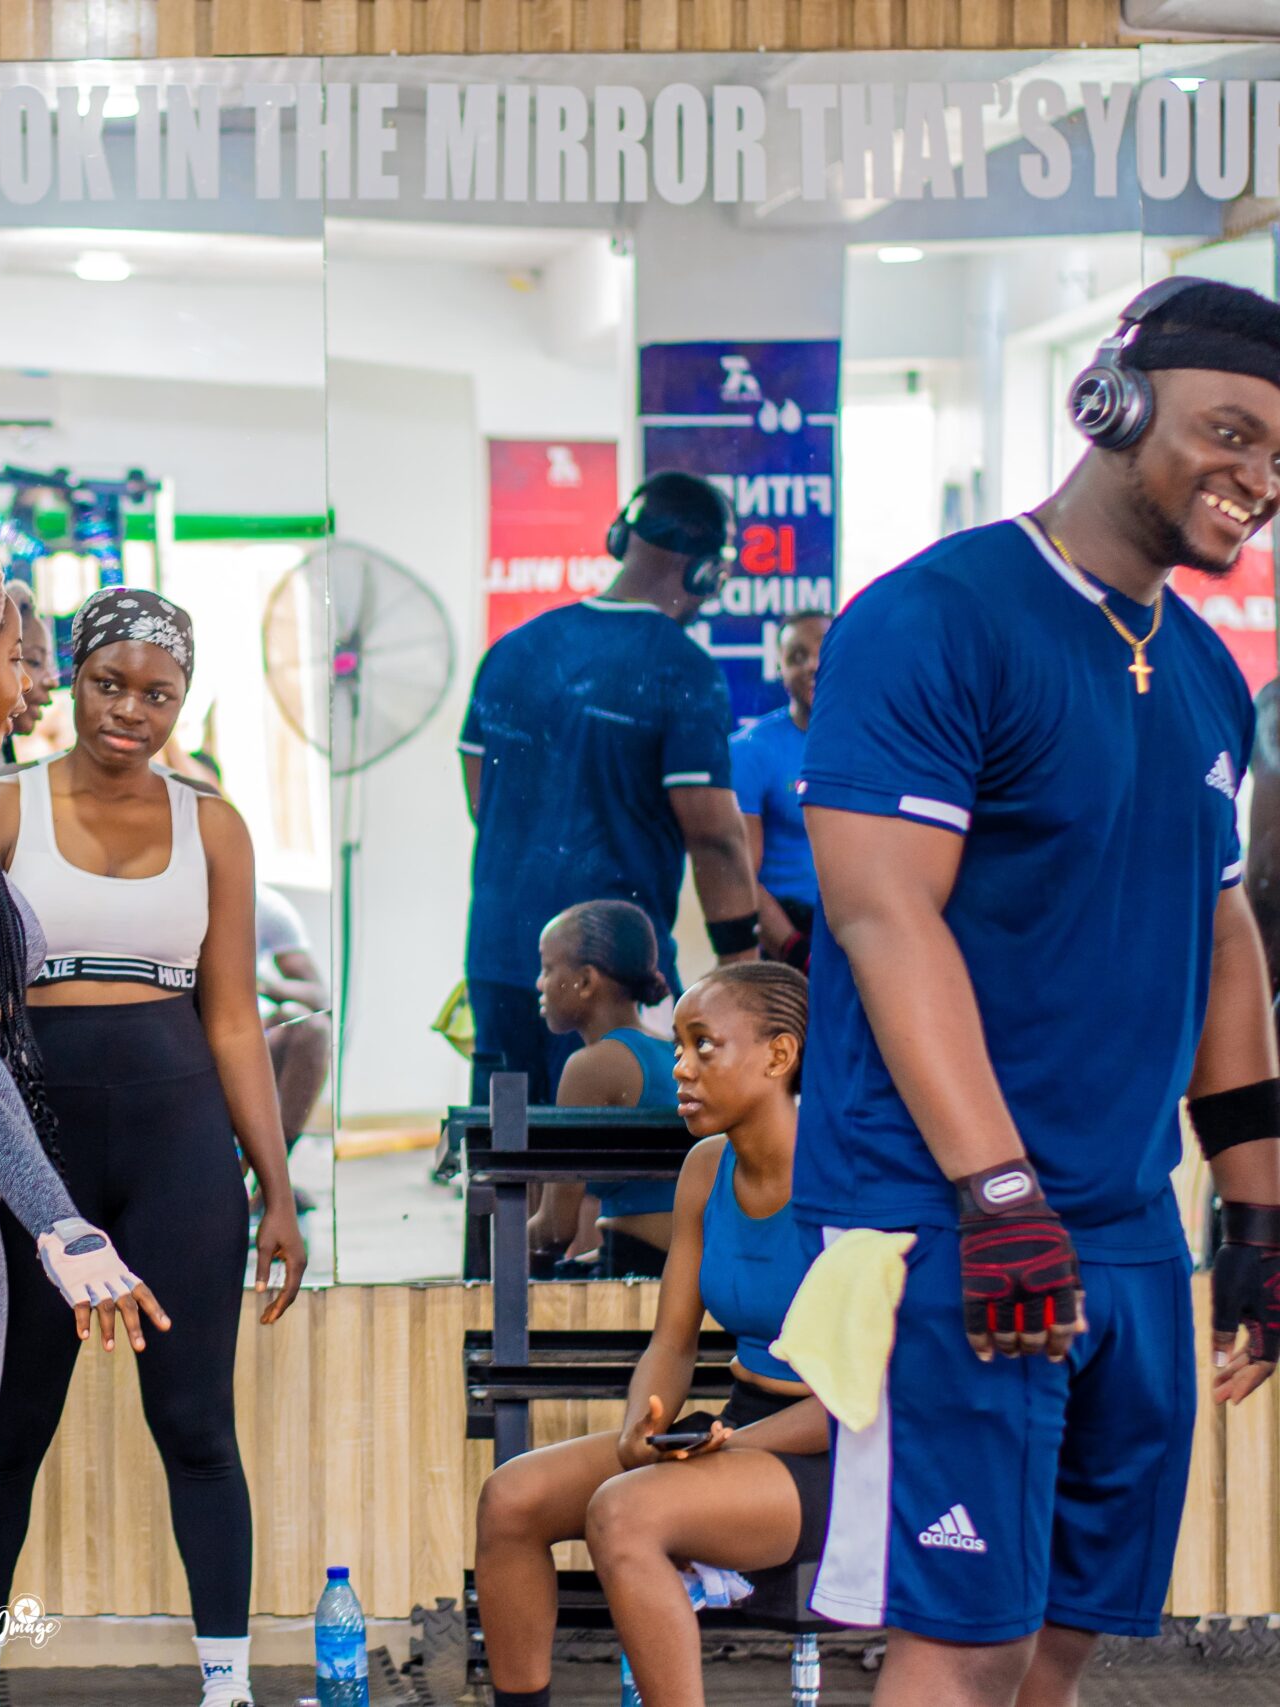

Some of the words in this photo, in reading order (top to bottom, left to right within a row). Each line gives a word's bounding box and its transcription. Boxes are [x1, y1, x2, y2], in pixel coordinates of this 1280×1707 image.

[135, 83, 220, 201] IN
[243, 83, 400, 201] THE
[423, 83, 768, 205] MIRROR
[787, 79, 1073, 200] THAT'S
[918, 1531, 987, 1553] adidas
